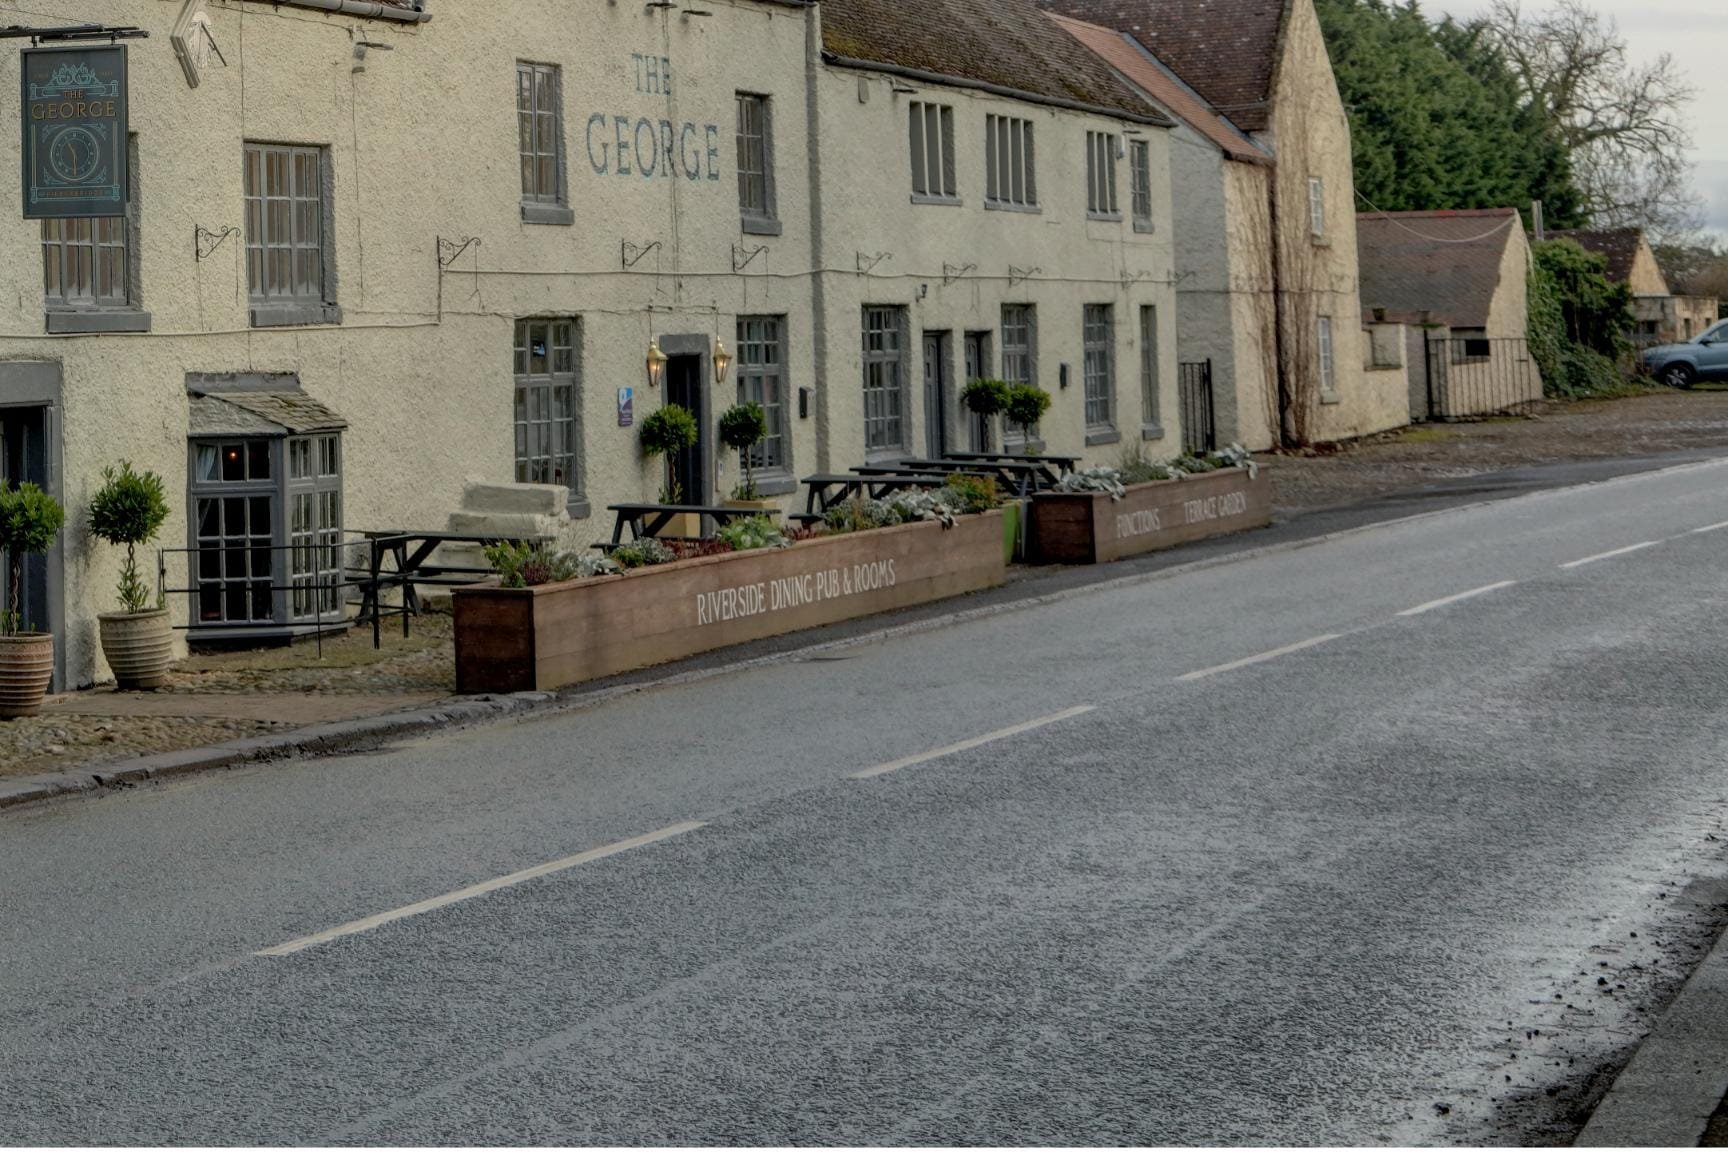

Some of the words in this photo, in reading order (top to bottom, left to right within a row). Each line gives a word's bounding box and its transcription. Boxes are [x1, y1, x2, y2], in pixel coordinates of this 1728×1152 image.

[63, 89, 85, 100] THE
[632, 52, 672, 96] THE
[32, 100, 117, 121] GEORGE
[587, 112, 719, 181] GEORGE
[696, 582, 767, 626] RIVERSIDE
[771, 574, 813, 611] DINING
[816, 568, 840, 601] PUB
[843, 567, 853, 596] &
[854, 559, 897, 594] ROOMS
